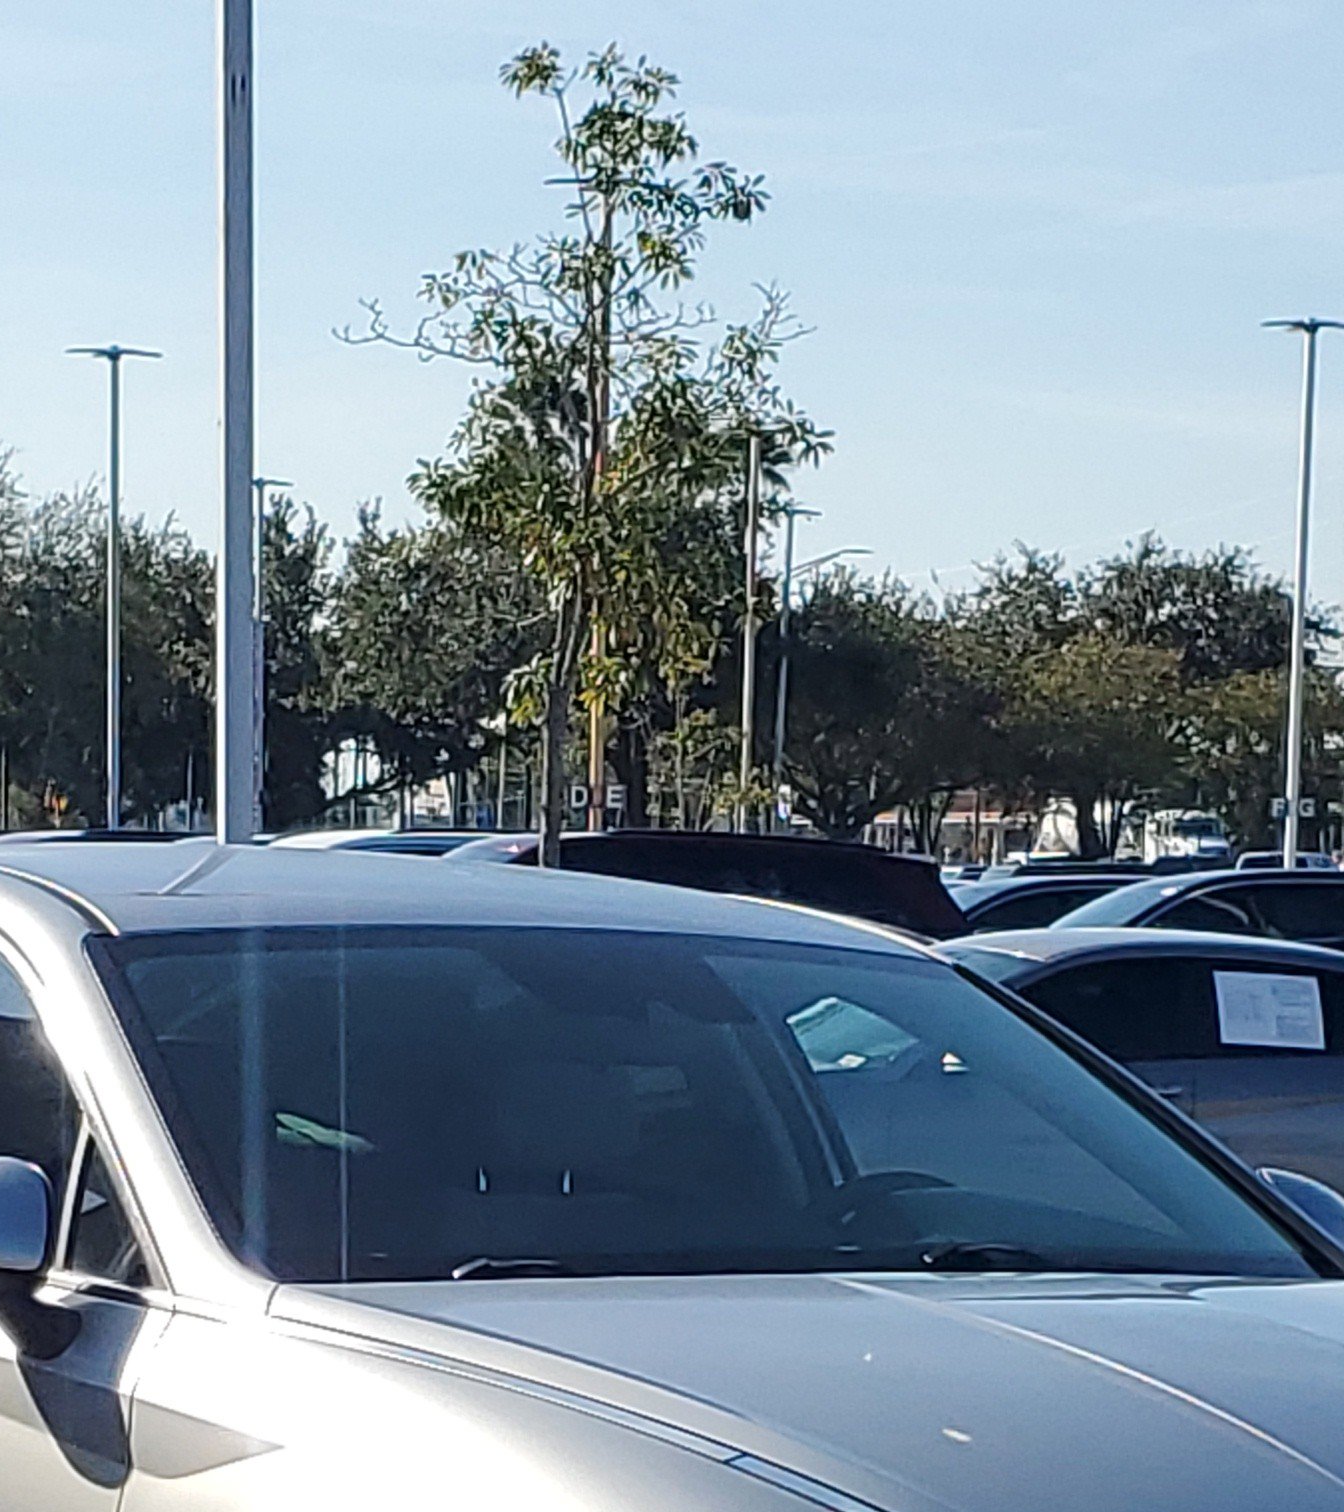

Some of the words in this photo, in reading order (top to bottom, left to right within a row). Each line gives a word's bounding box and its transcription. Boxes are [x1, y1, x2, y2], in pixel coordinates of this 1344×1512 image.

[571, 786, 588, 808] D
[606, 785, 625, 809] E
[1271, 798, 1285, 817] F
[1299, 798, 1315, 817] G
